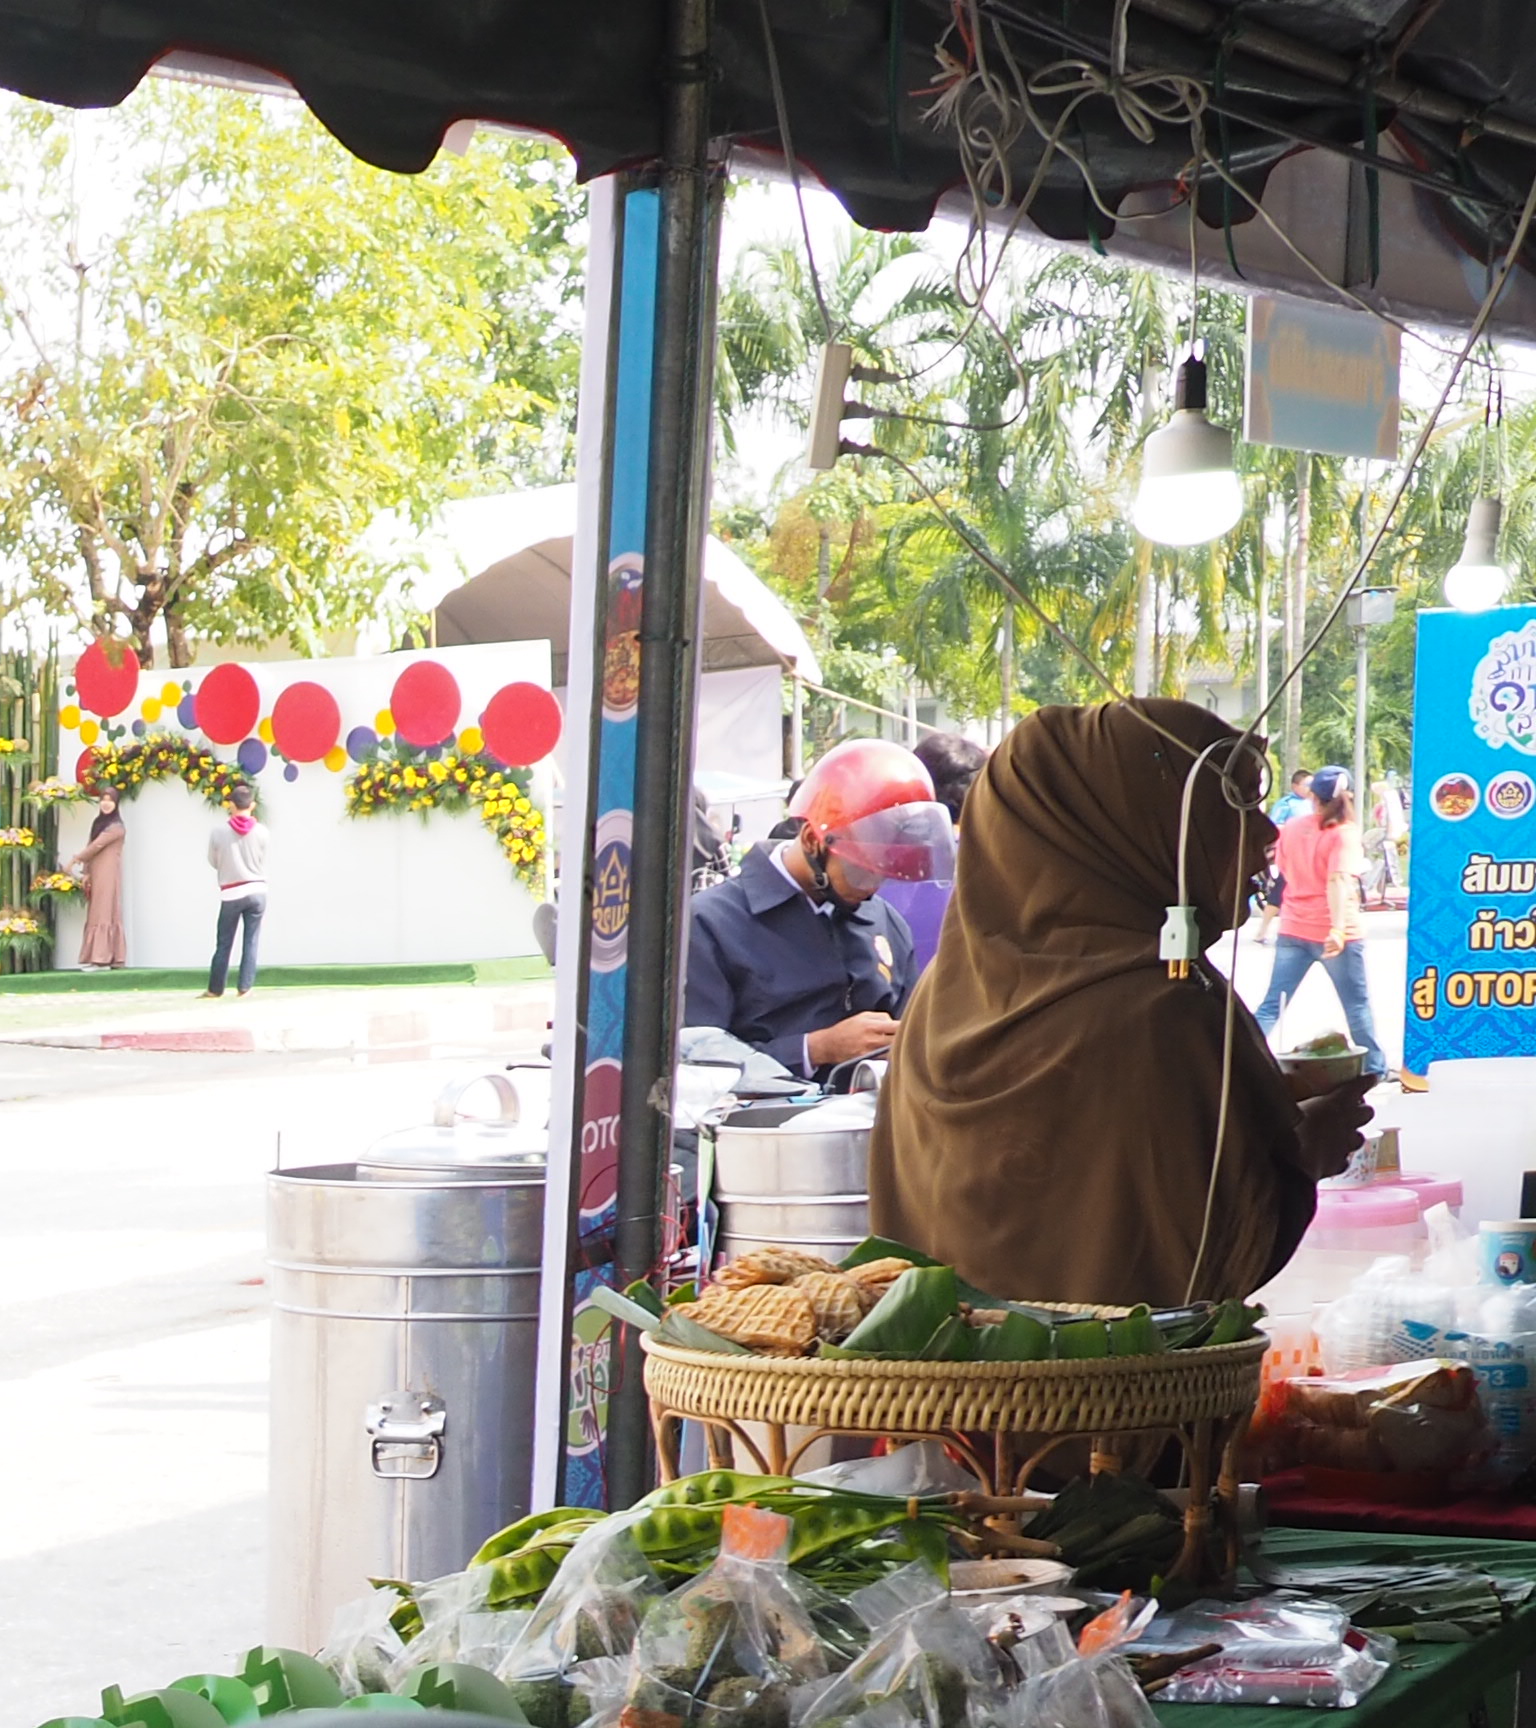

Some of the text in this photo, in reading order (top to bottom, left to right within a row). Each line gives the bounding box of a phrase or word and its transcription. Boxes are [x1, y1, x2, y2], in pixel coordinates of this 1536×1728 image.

[1463, 854, 1536, 893] สัมม
[1470, 909, 1536, 949] ก้าว
[1412, 967, 1437, 1019] สู่
